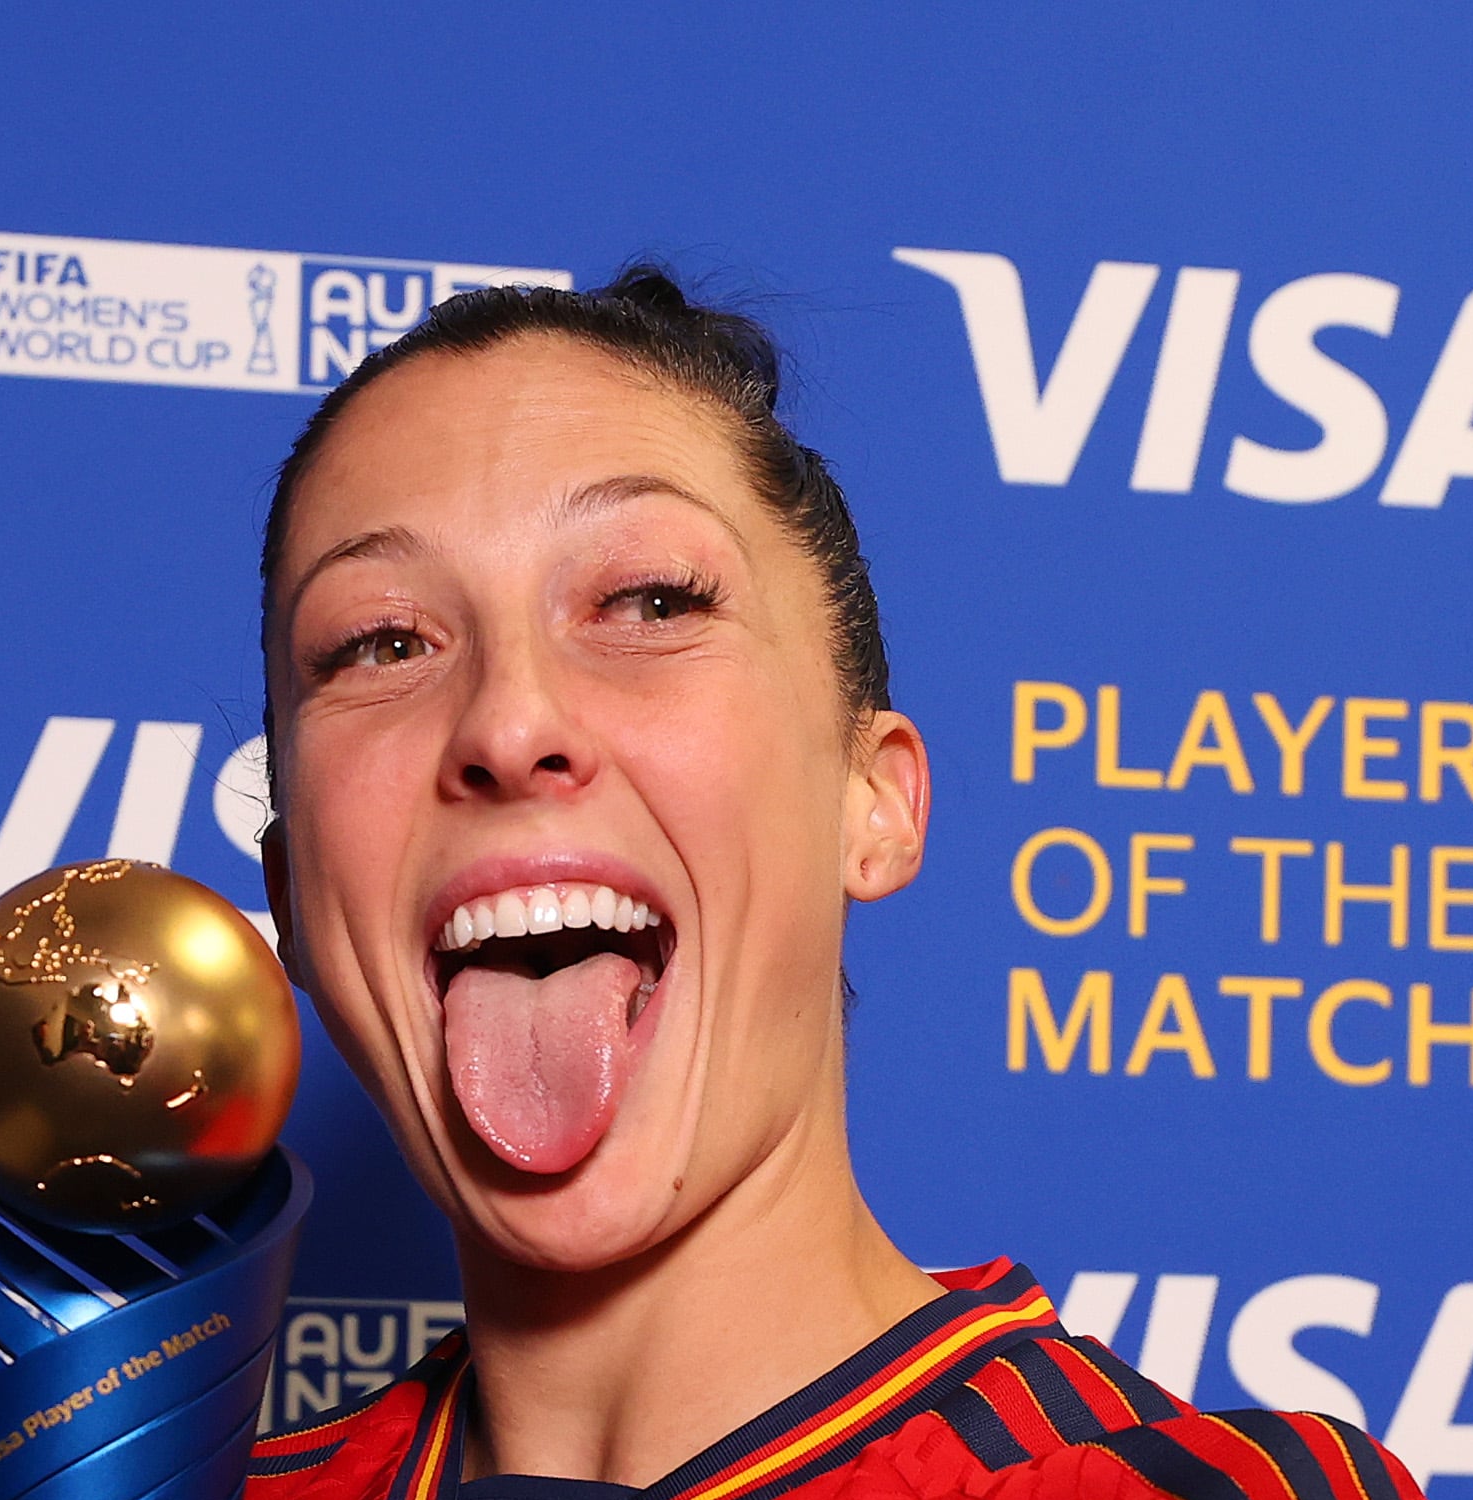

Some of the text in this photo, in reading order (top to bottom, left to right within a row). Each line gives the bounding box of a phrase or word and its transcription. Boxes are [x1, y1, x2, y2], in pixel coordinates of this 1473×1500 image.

[311, 269, 424, 330] AU
[147, 338, 230, 371] CUP
[311, 326, 412, 382] N
[1010, 826, 1195, 938] OF
[286, 1312, 397, 1368] AU
[23, 1386, 94, 1438] Player
[96, 1367, 121, 1395] of
[122, 1350, 163, 1380] the
[160, 1312, 231, 1359] Match
